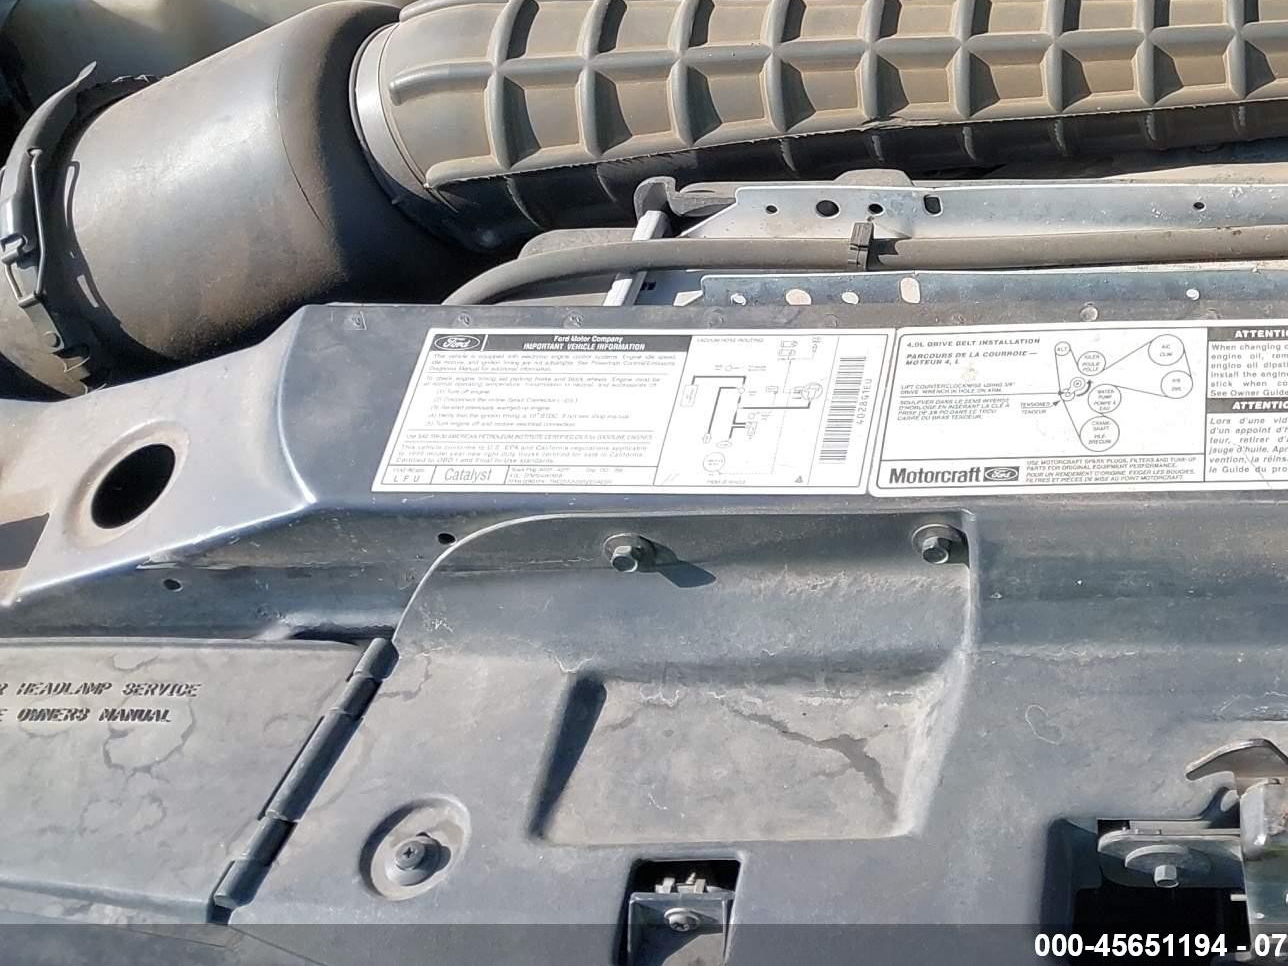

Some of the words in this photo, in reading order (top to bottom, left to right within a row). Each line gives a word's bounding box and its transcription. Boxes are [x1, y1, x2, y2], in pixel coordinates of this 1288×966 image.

[443, 337, 471, 348] Ford
[591, 335, 624, 344] Company
[979, 338, 1040, 346] INSTALLATION
[523, 343, 565, 351] IMPORTANT
[567, 343, 596, 351] VEHICLE
[596, 343, 646, 351] INFORMATION
[1211, 343, 1236, 351] When
[1239, 342, 1281, 352] changing
[1211, 352, 1242, 361] engine
[1250, 352, 1268, 360] oil,
[1211, 362, 1242, 370] engine
[1211, 370, 1239, 378] install
[1243, 370, 1257, 378] the
[1243, 379, 1267, 387] when
[1210, 389, 1227, 398] See
[1230, 389, 1259, 398] Owner
[444, 468, 492, 484] Catalyst
[889, 467, 981, 484] Motorcraft
[16, 682, 112, 696] HEADLAMP
[122, 683, 202, 697] SERVICE
[17, 708, 90, 722] OWNERS
[99, 708, 172, 722] MANUAL
